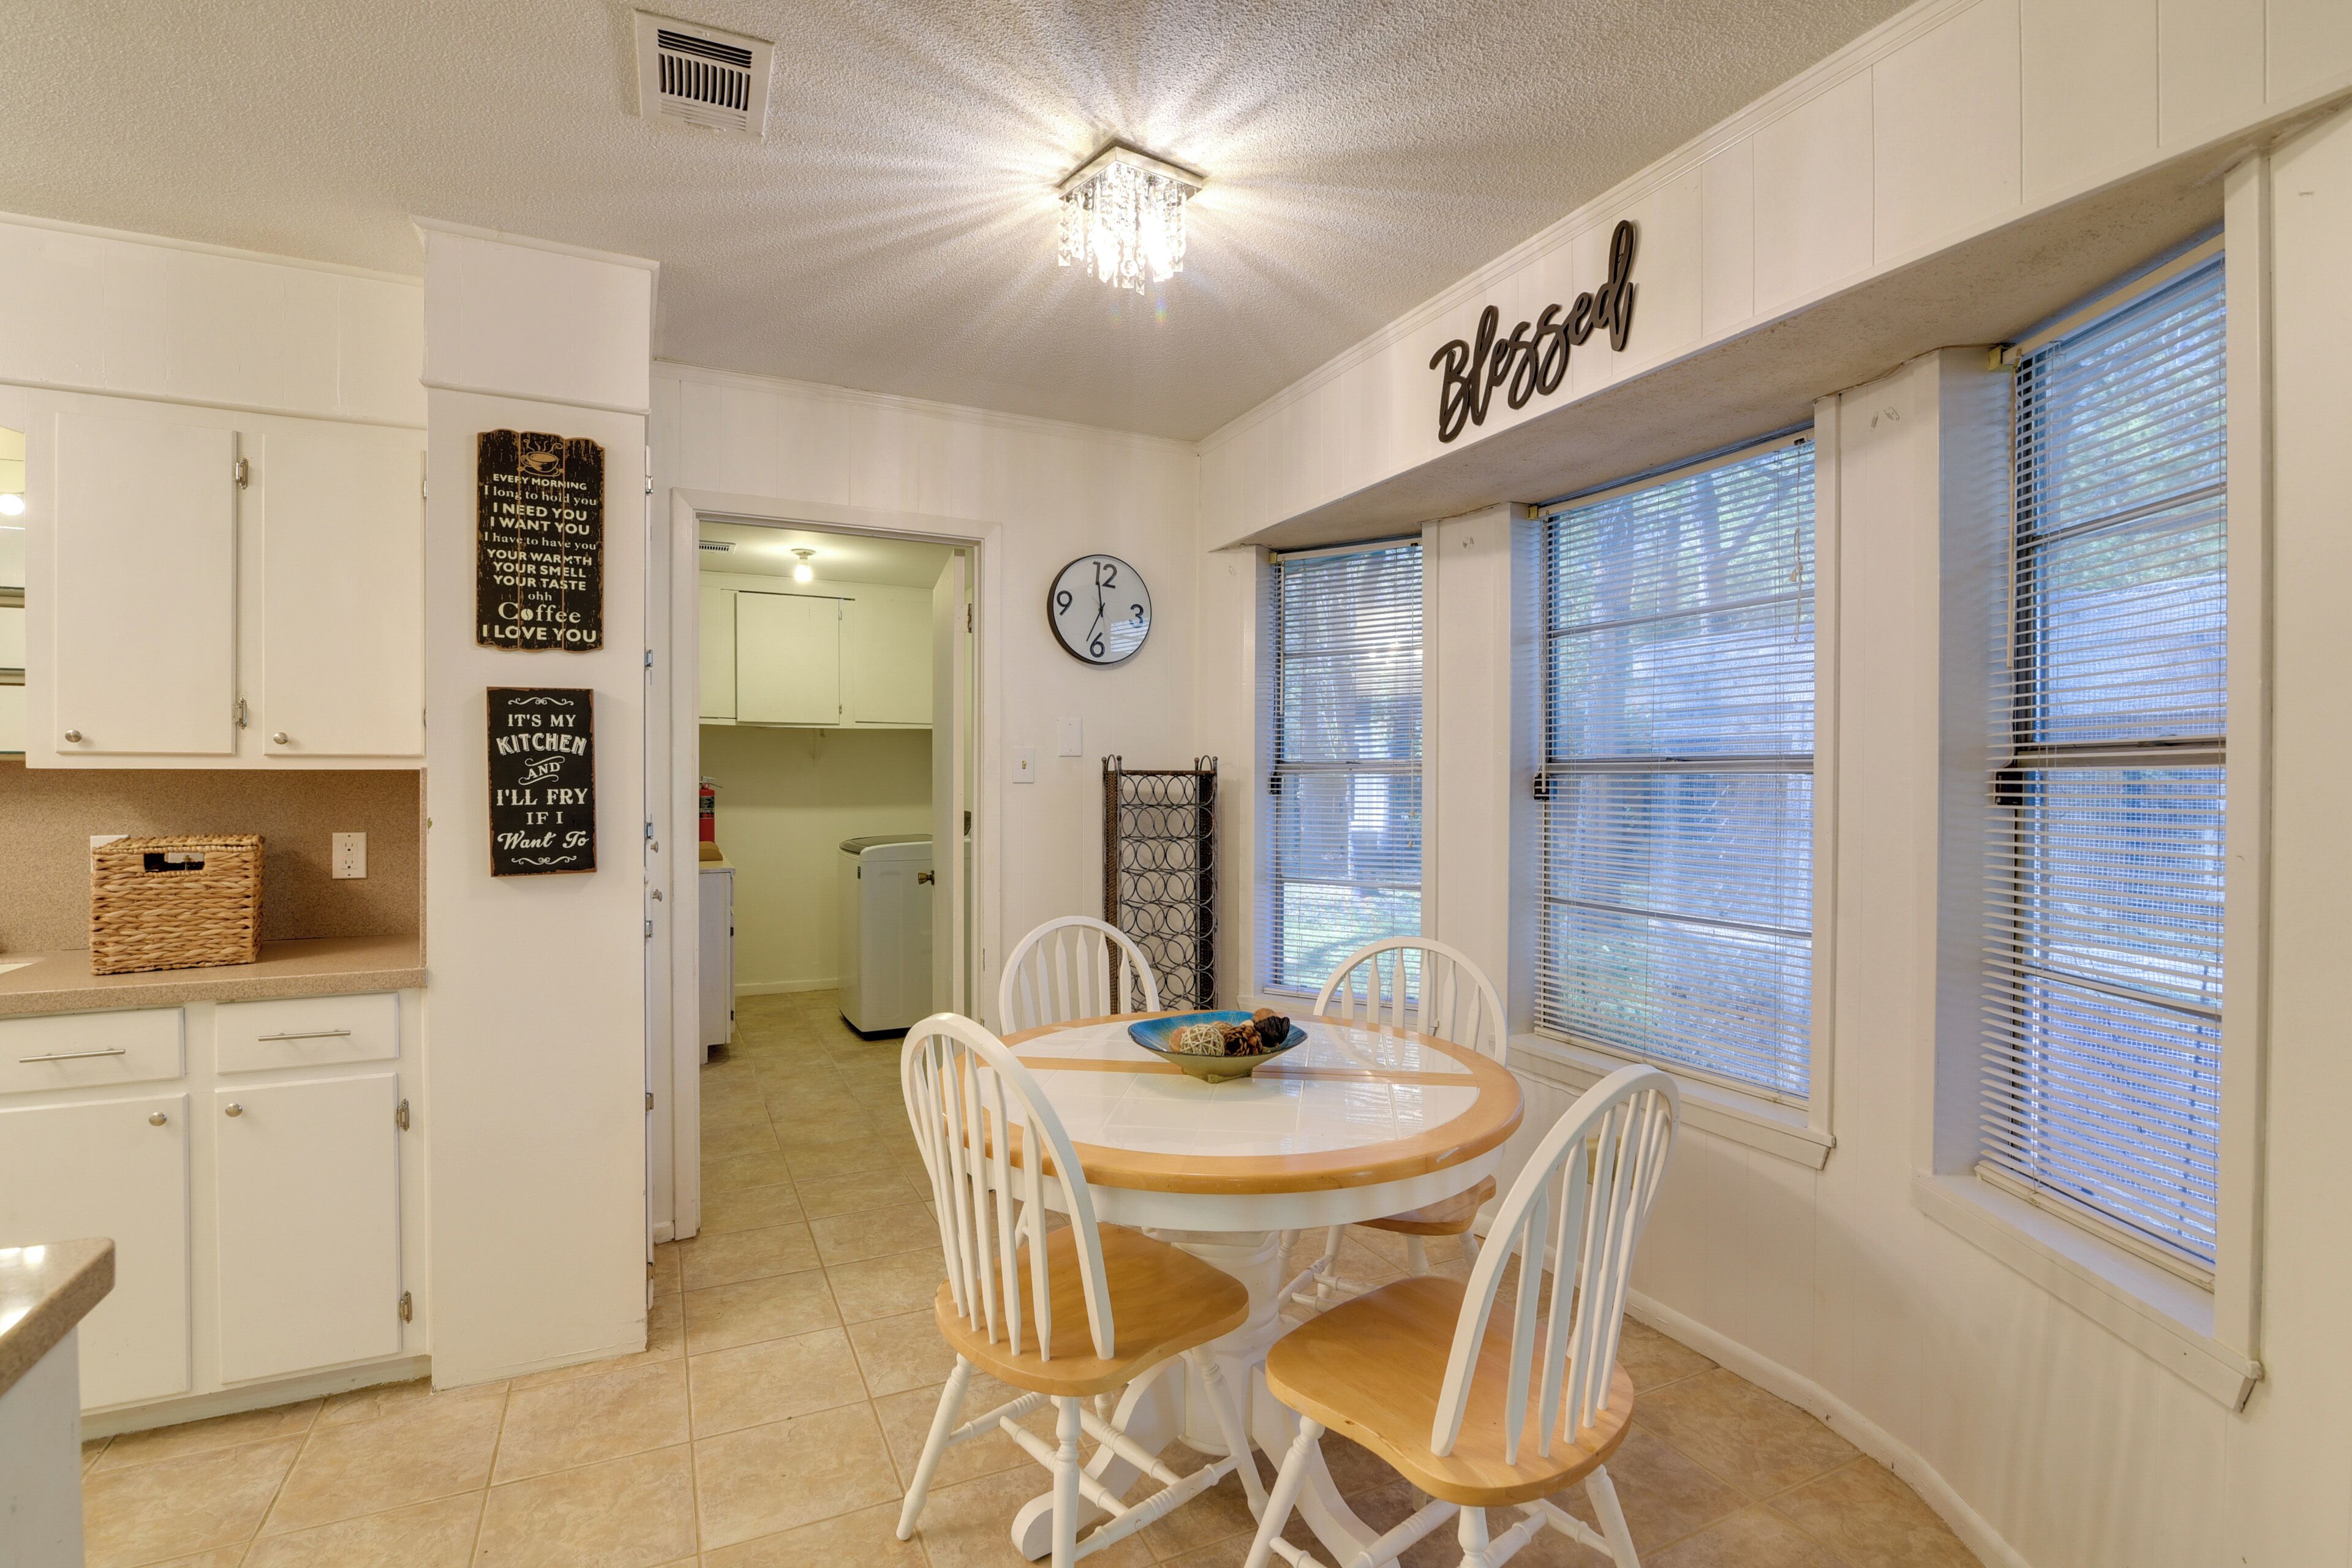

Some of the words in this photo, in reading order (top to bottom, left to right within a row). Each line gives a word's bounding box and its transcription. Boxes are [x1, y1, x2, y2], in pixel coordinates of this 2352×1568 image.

[1430, 220, 1634, 443] Blessed
[493, 473, 529, 484] EVERY
[532, 478, 587, 490] MORNING
[484, 484, 489, 495] I
[493, 486, 522, 500] long
[526, 489, 538, 500] to
[542, 491, 570, 503] hold
[574, 497, 597, 507] you
[493, 502, 497, 513] I
[503, 503, 548, 517] NEED
[552, 508, 587, 521] YOU
[491, 516, 495, 527] I
[499, 517, 551, 532] WANT
[554, 522, 590, 535] YOU
[484, 532, 489, 541] I
[493, 532, 522, 545] have
[527, 536, 538, 545] to
[542, 536, 571, 548] have
[575, 541, 597, 551] you
[487, 549, 527, 561] YOUR
[530, 552, 592, 565] WARMTH
[493, 562, 537, 574] YOUR
[540, 566, 587, 578] SMELL
[1093, 561, 1117, 589] 12
[493, 575, 537, 587] YOUR
[540, 578, 586, 590] TASTE
[528, 591, 552, 601] ohh
[1057, 590, 1072, 616] 9
[498, 601, 581, 624] Coffee
[1129, 604, 1144, 628] 3
[482, 624, 488, 637] I
[494, 625, 547, 641] LOVE
[553, 627, 597, 643] YOU
[1090, 632, 1105, 657] 6
[508, 714, 541, 727] IT'S
[551, 714, 576, 727] MY
[496, 733, 587, 756] KITCHEN
[526, 762, 560, 780] AND
[496, 789, 538, 805] I'LL
[547, 788, 588, 805] FRY
[526, 812, 548, 824] IF
[556, 812, 563, 824] I
[497, 830, 556, 850] Want
[562, 831, 589, 848] To
